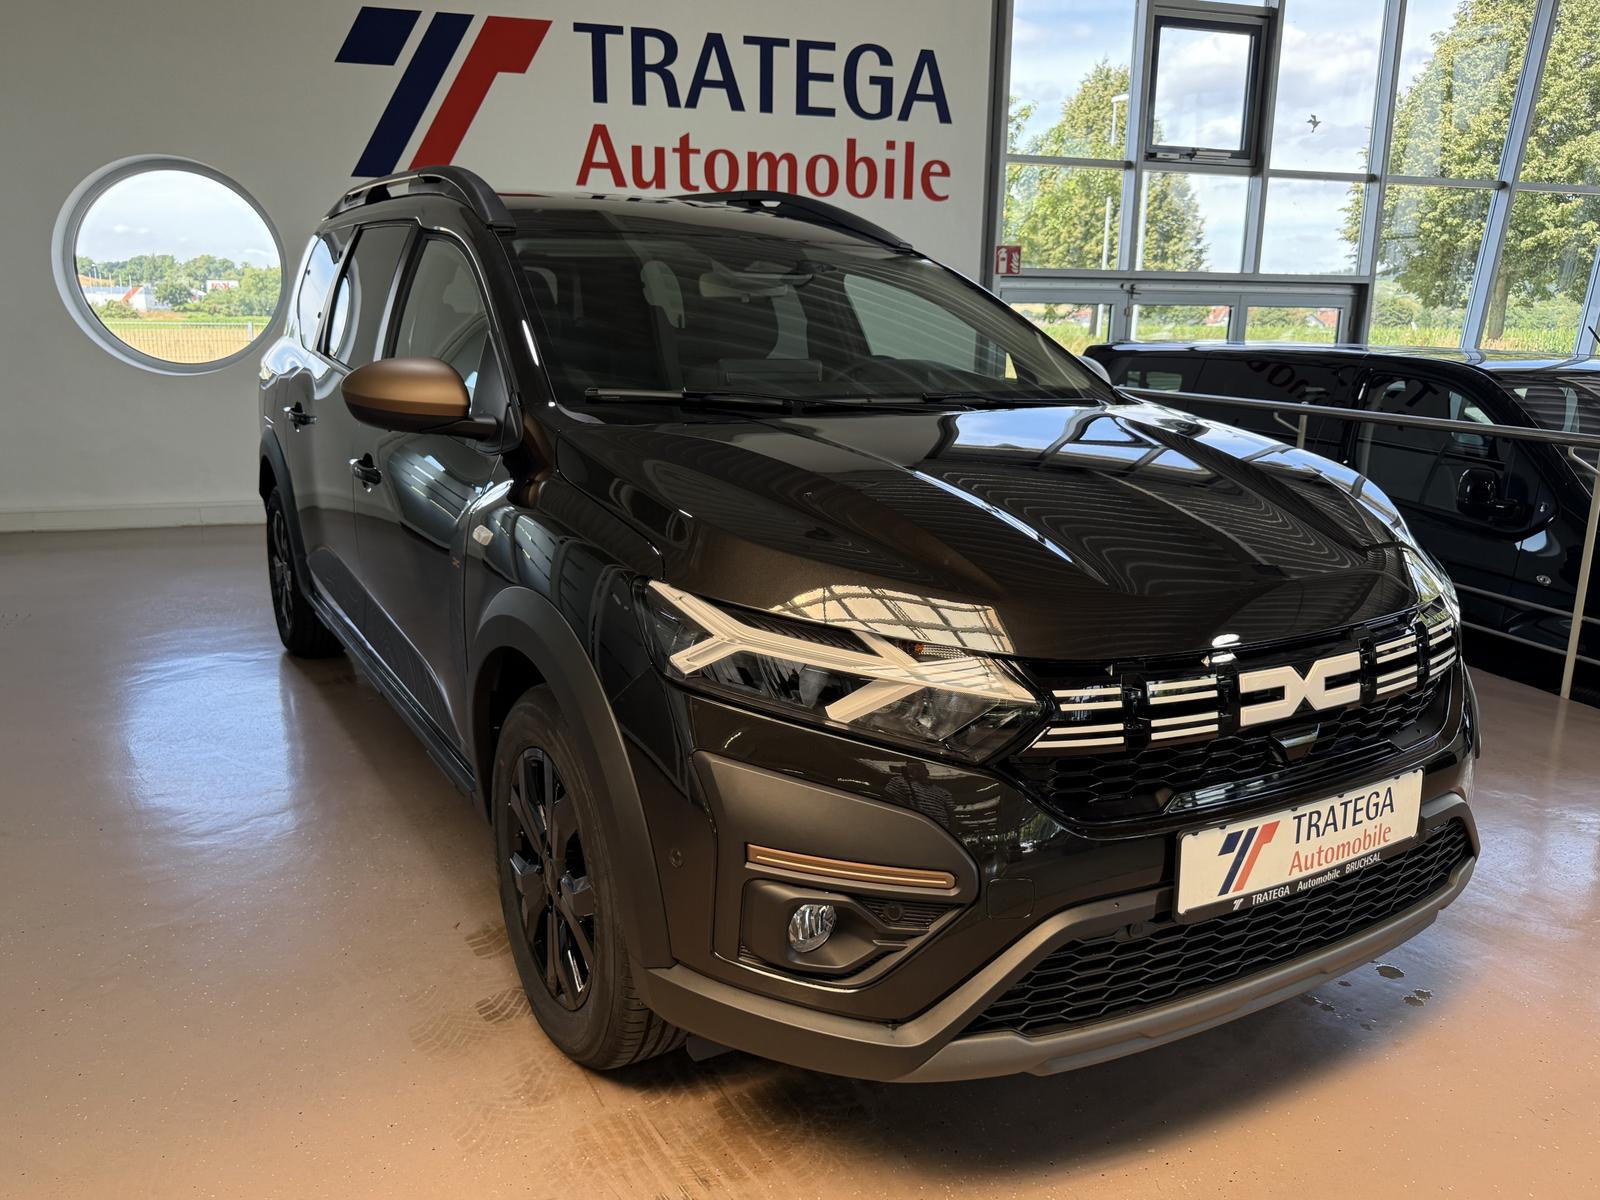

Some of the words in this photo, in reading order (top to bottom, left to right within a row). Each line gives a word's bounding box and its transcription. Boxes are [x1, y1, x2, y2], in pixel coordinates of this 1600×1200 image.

[573, 22, 953, 125] TRATEGA
[575, 123, 952, 202] Automobile
[1293, 786, 1395, 844] TRATEGA
[1251, 885, 1290, 905] TRATEGA
[1297, 868, 1341, 892] Automobile
[1345, 852, 1382, 874] BRUCHSAL
[1287, 823, 1392, 876] Automobile
